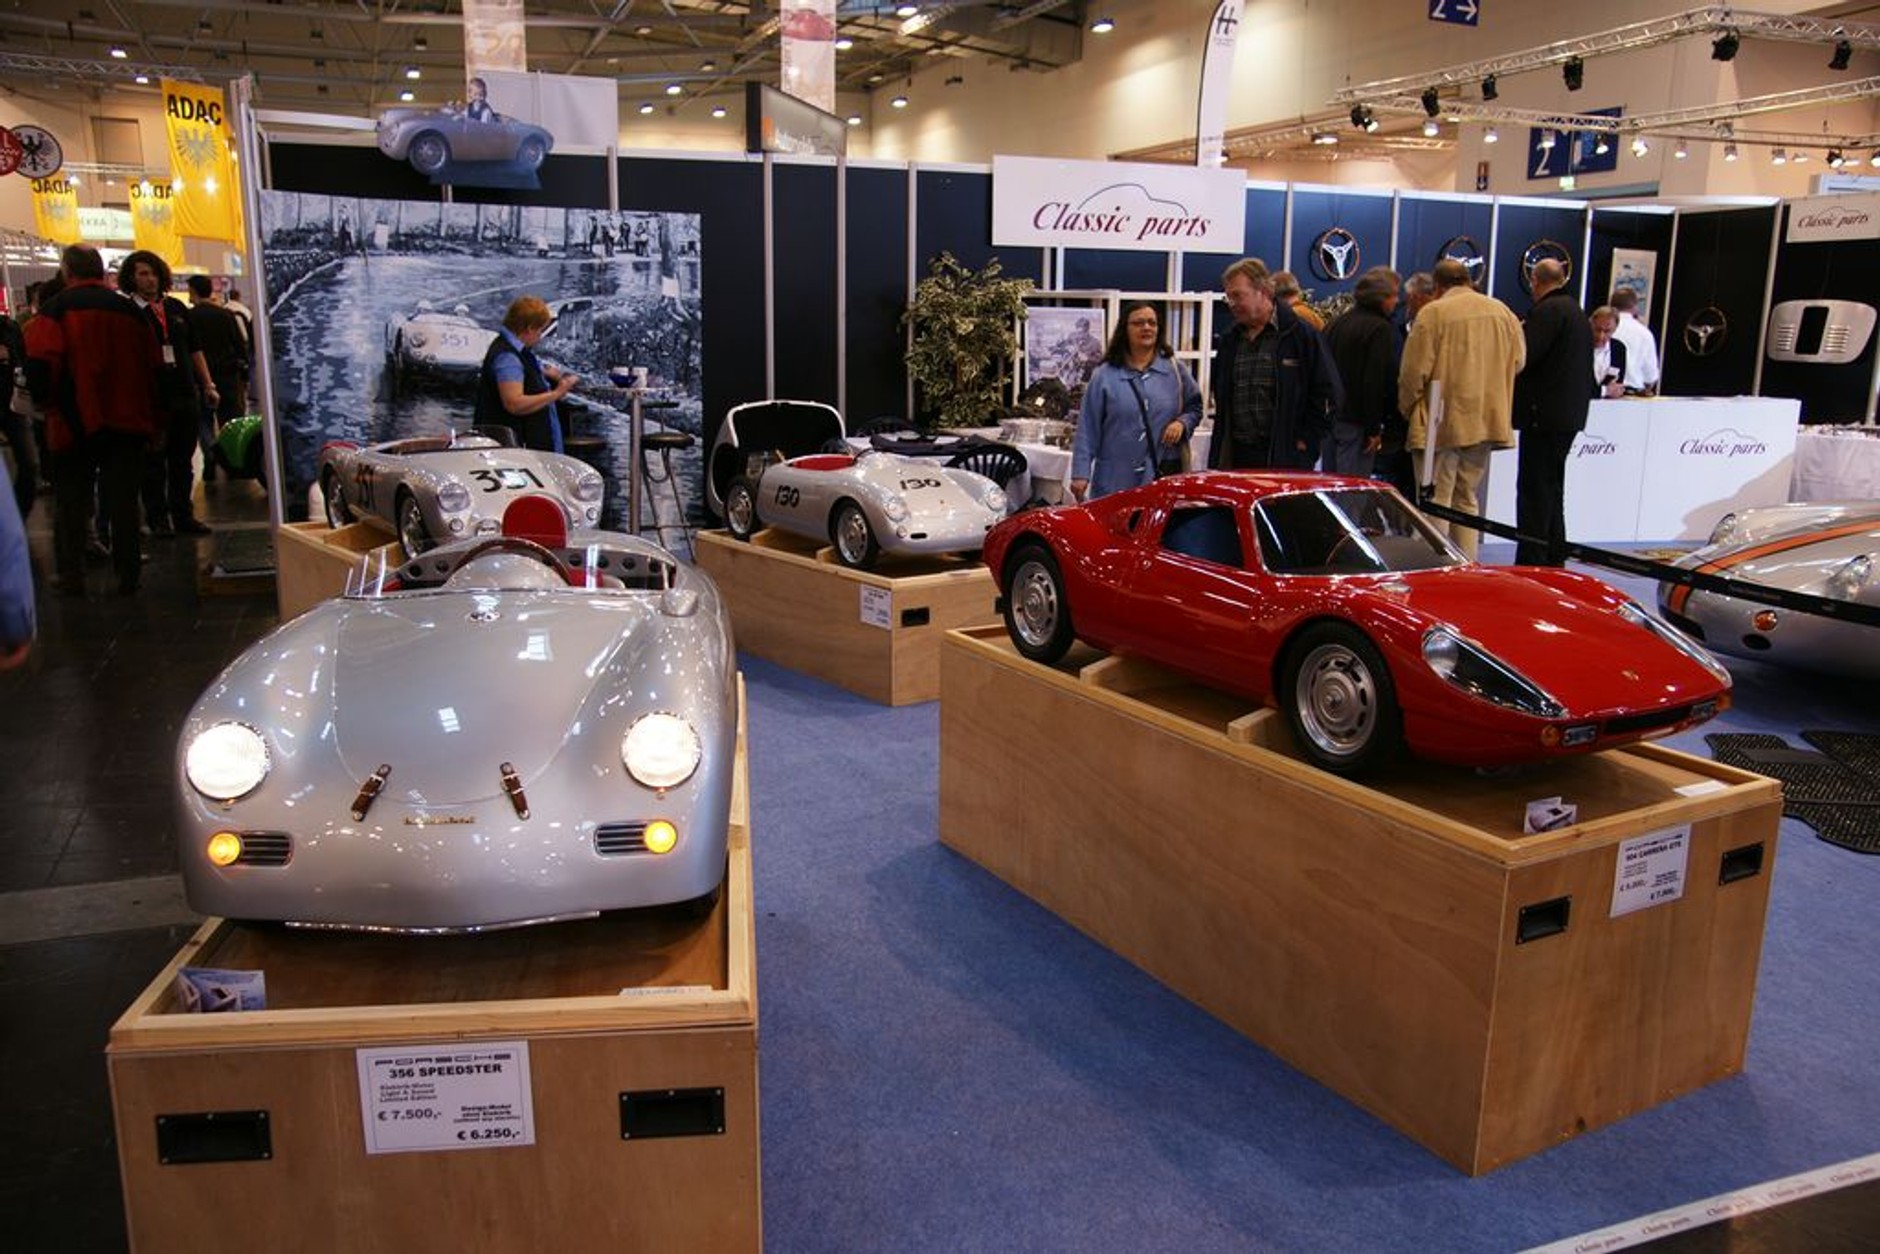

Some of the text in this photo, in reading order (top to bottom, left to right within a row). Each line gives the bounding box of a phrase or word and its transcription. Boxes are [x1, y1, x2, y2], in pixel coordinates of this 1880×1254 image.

[168, 94, 221, 126] ADAC
[1033, 201, 1211, 241] Classic parts
[1798, 212, 1869, 229] Classic parts
[441, 332, 469, 347] 351
[1577, 442, 1617, 458] parts
[1680, 438, 1767, 457] Classic parts
[469, 468, 545, 493] 351
[900, 478, 942, 491] 130
[774, 484, 800, 508] 130
[388, 1063, 503, 1079] 356 SPEEDSTER
[378, 1108, 442, 1121] € 7.500,-
[457, 1127, 521, 1141] € 6.250,-
